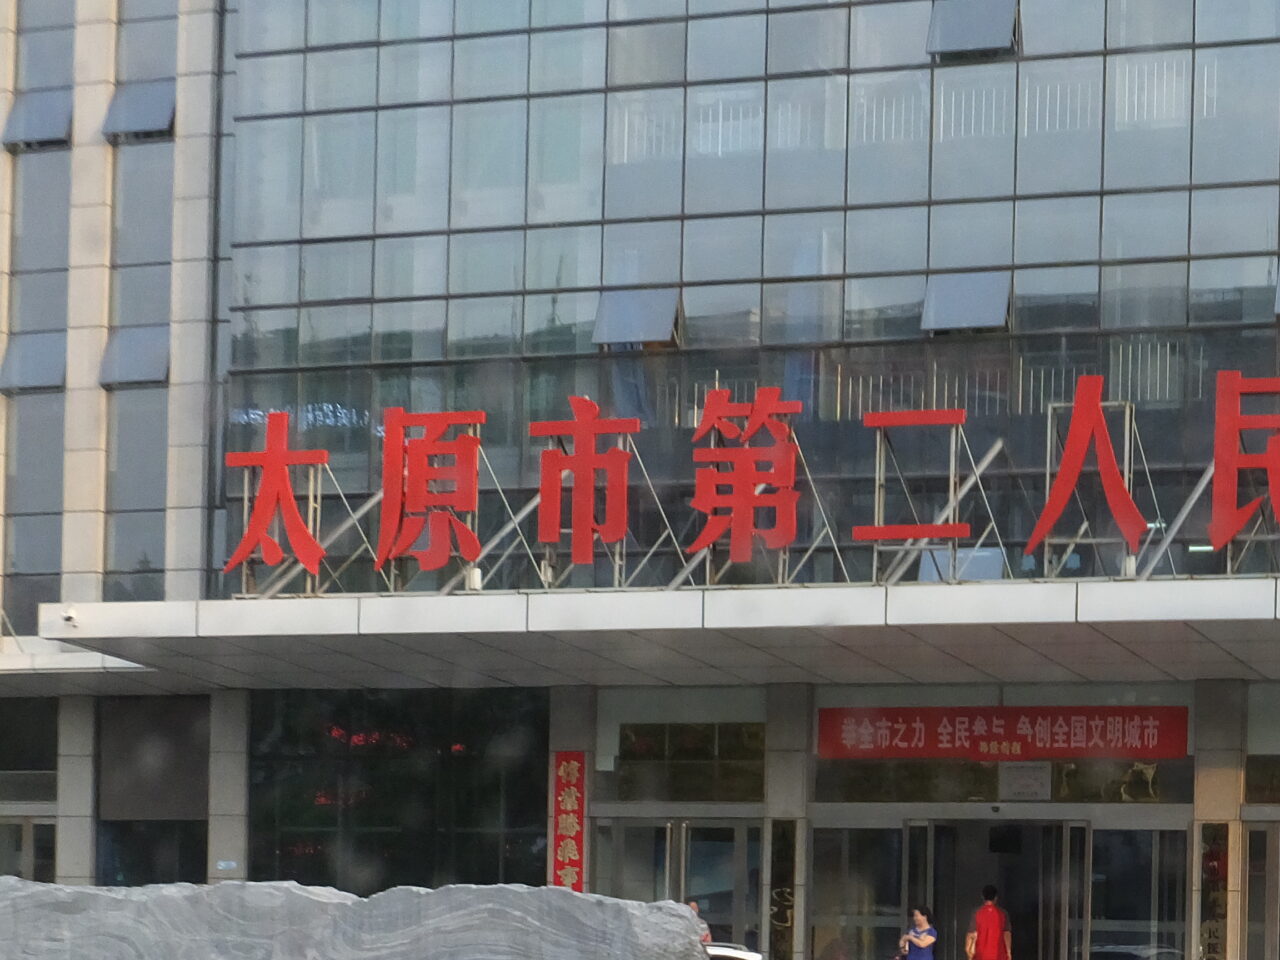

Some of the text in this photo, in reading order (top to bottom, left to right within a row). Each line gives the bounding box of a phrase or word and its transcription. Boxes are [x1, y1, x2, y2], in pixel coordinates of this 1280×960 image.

[842, 715, 926, 750] 举全市之力
